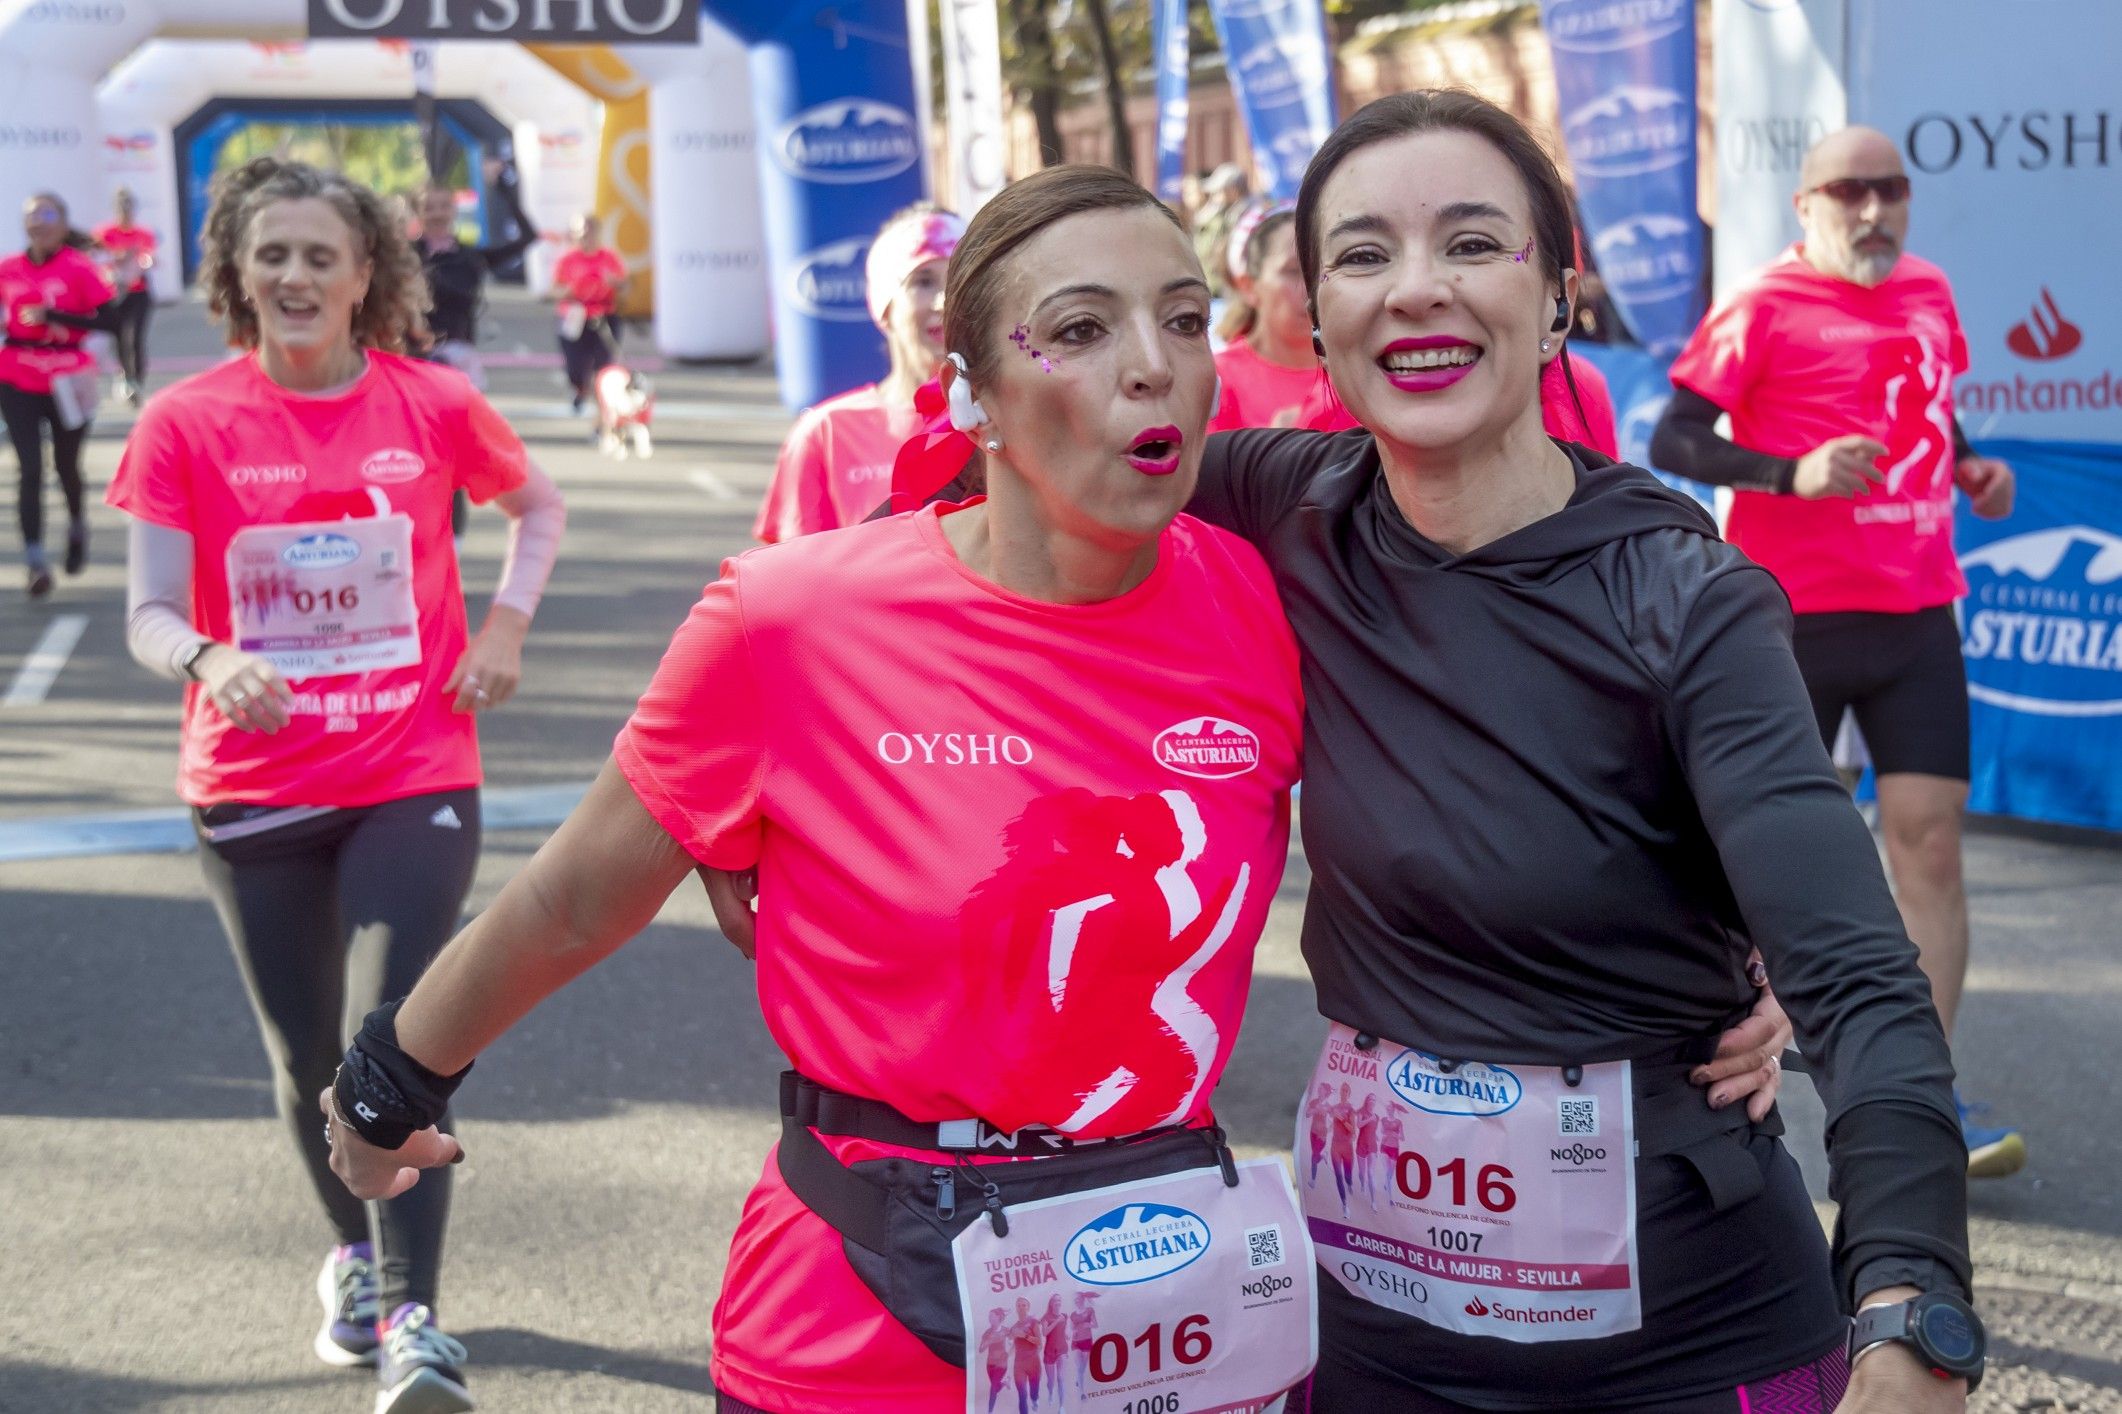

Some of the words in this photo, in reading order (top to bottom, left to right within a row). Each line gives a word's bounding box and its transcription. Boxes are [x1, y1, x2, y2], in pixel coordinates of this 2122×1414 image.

[1906, 110, 2122, 174] OYSH
[229, 464, 307, 486] OYSHO
[294, 584, 360, 614] 016
[1963, 608, 2122, 672] STURIA
[877, 732, 1033, 766] OYSHO
[1163, 740, 1256, 765] ASTURIANA
[1175, 738, 1215, 747] CENTRAL
[1330, 1038, 1344, 1051] TU
[1327, 1052, 1378, 1082] SUMA
[1393, 1059, 1512, 1105] ASTURIANA
[1395, 1150, 1518, 1214] 016
[1094, 1230, 1142, 1247] CENTRAL
[1146, 1219, 1193, 1236] LECHERA
[1426, 1226, 1484, 1253] 1007
[984, 1260, 1001, 1273] TU
[1005, 1249, 1054, 1269] DORSAL
[1076, 1230, 1203, 1274] ASTURIANA
[1346, 1231, 1405, 1261] CARRERA
[1408, 1251, 1425, 1267] DE
[1429, 1255, 1446, 1273] LA
[1450, 1261, 1503, 1281] MUJER
[1517, 1268, 1583, 1286] SEVILLA
[990, 1263, 1058, 1293] SUMA
[1341, 1261, 1428, 1304] OYSHO
[1492, 1302, 1598, 1324] Santander
[1088, 1314, 1213, 1383] 016
[1122, 1391, 1180, 1414] 1006
